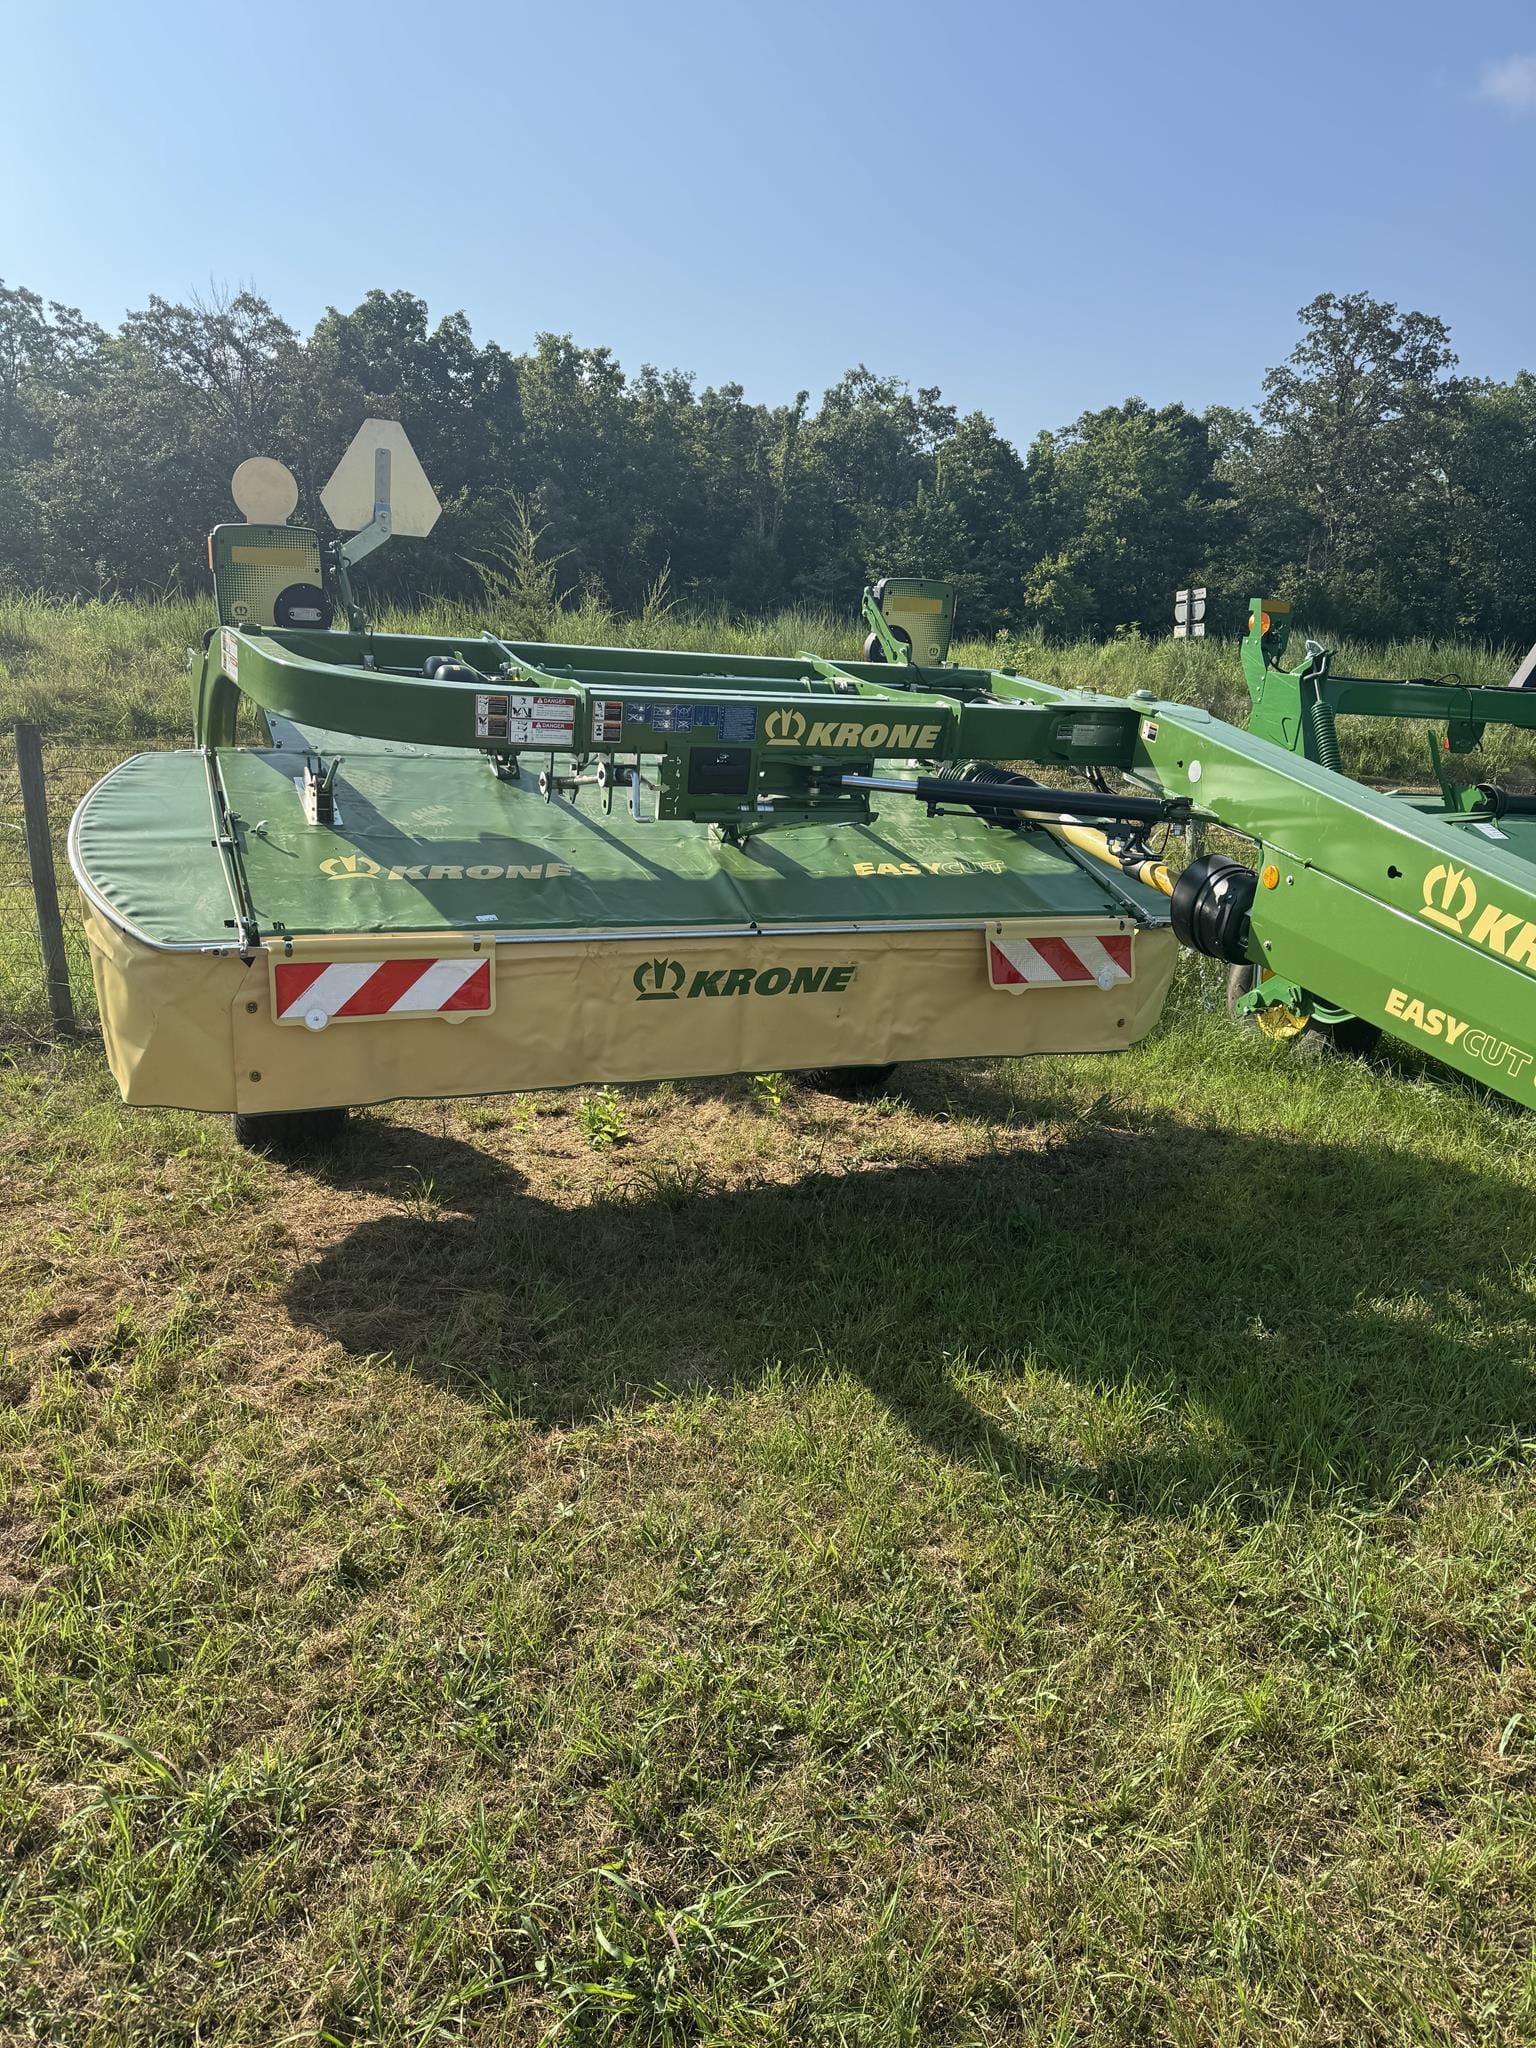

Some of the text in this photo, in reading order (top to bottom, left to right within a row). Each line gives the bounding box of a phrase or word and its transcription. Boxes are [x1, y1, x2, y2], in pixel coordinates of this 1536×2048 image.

[805, 721, 943, 749] KRONE
[387, 862, 573, 881] KRONE
[852, 861, 1008, 876] EASYCUT
[686, 966, 857, 999] KRONE
[1384, 987, 1534, 1078] EASYCUT
